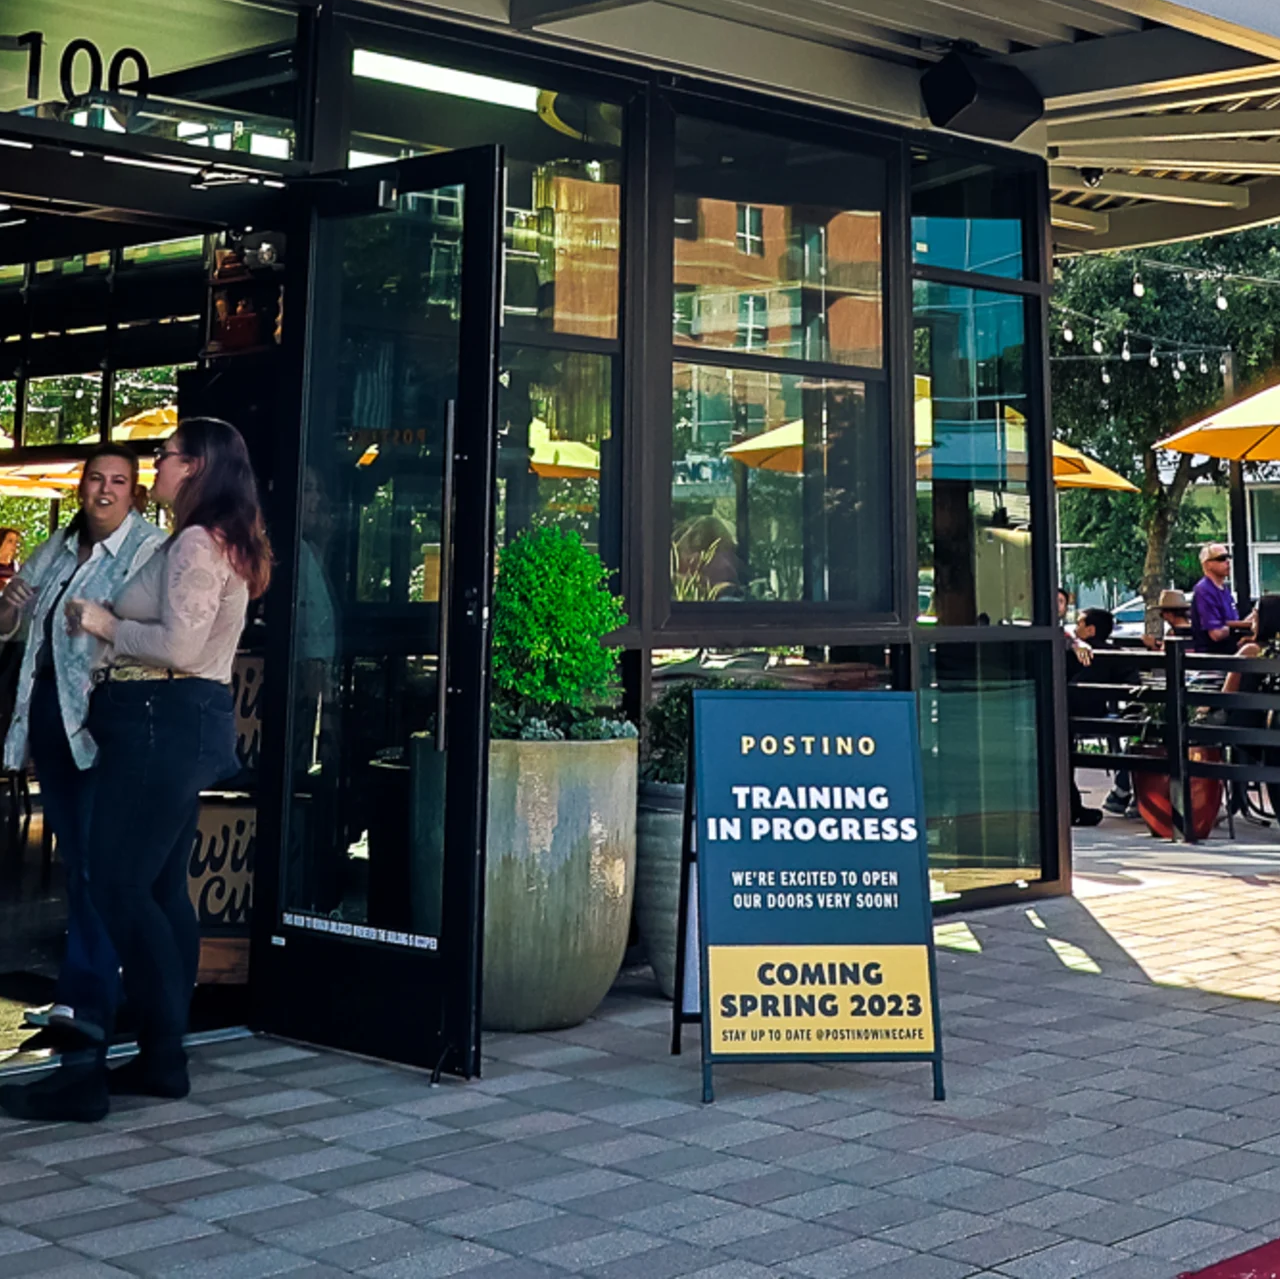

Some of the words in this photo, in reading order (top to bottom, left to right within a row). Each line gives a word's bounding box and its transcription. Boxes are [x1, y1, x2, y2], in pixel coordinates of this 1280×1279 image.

[740, 735, 876, 756] POSTINO
[731, 786, 889, 810] TRAINING
[707, 818, 741, 841] IN
[751, 817, 918, 842] PROGRESS
[732, 871, 776, 887] WE'RE
[780, 871, 837, 887] EXCITED
[840, 871, 858, 887] TO
[862, 871, 899, 887] OPEN
[733, 893, 762, 910] OUR
[767, 893, 813, 909] DOORS
[818, 893, 851, 909] VERY
[856, 893, 899, 909] SOON!
[757, 962, 883, 986] COMING
[720, 994, 839, 1018] SPRING
[850, 994, 923, 1018] 2023
[722, 1029, 747, 1042] STAY
[750, 1029, 766, 1041] UP
[768, 1029, 782, 1041] TO
[785, 1028, 812, 1041] DATE
